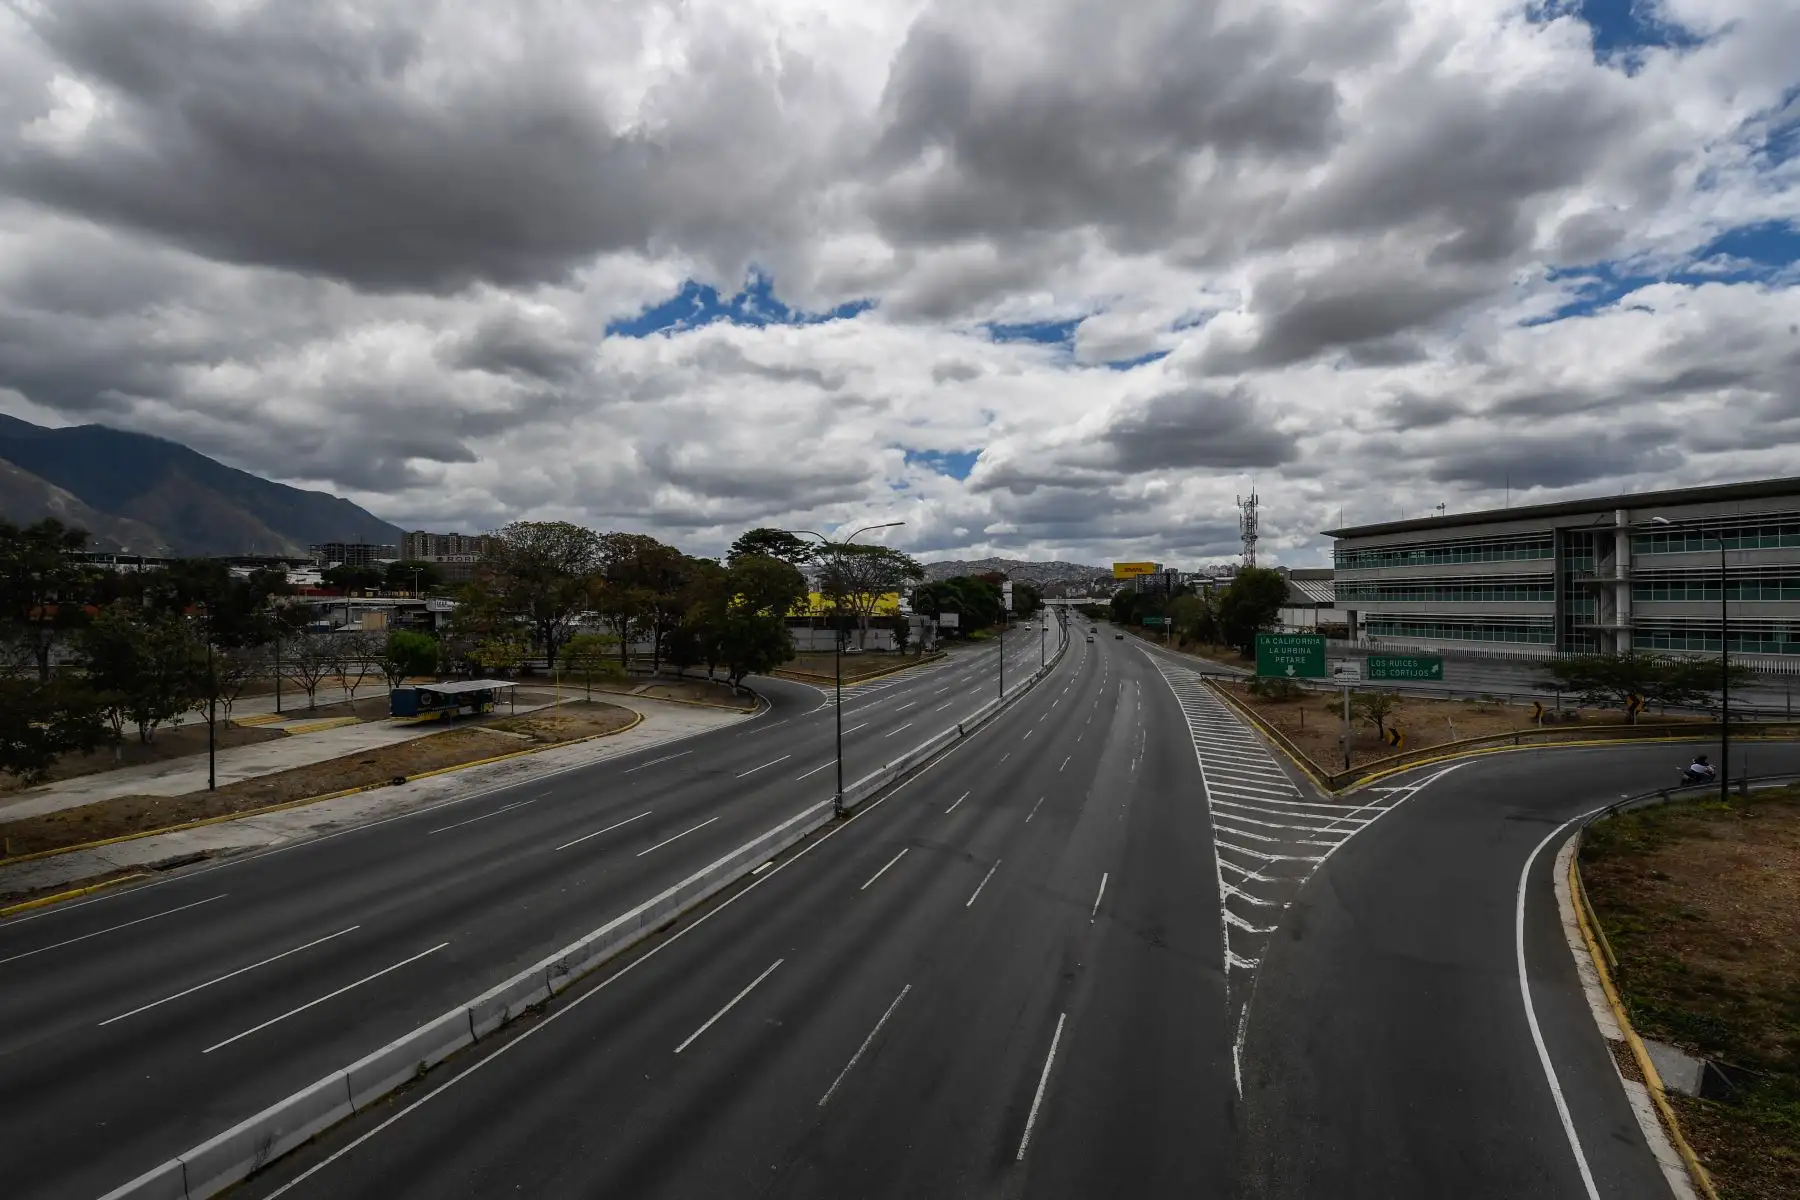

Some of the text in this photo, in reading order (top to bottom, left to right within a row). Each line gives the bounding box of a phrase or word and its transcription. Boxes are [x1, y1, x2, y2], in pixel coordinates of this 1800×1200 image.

[1260, 637, 1321, 645] LA CALIFORNIA
[1275, 656, 1307, 664] PETARE
[1371, 659, 1418, 667] LOS RUICES
[1371, 669, 1429, 677] LOS CORTIJOS
